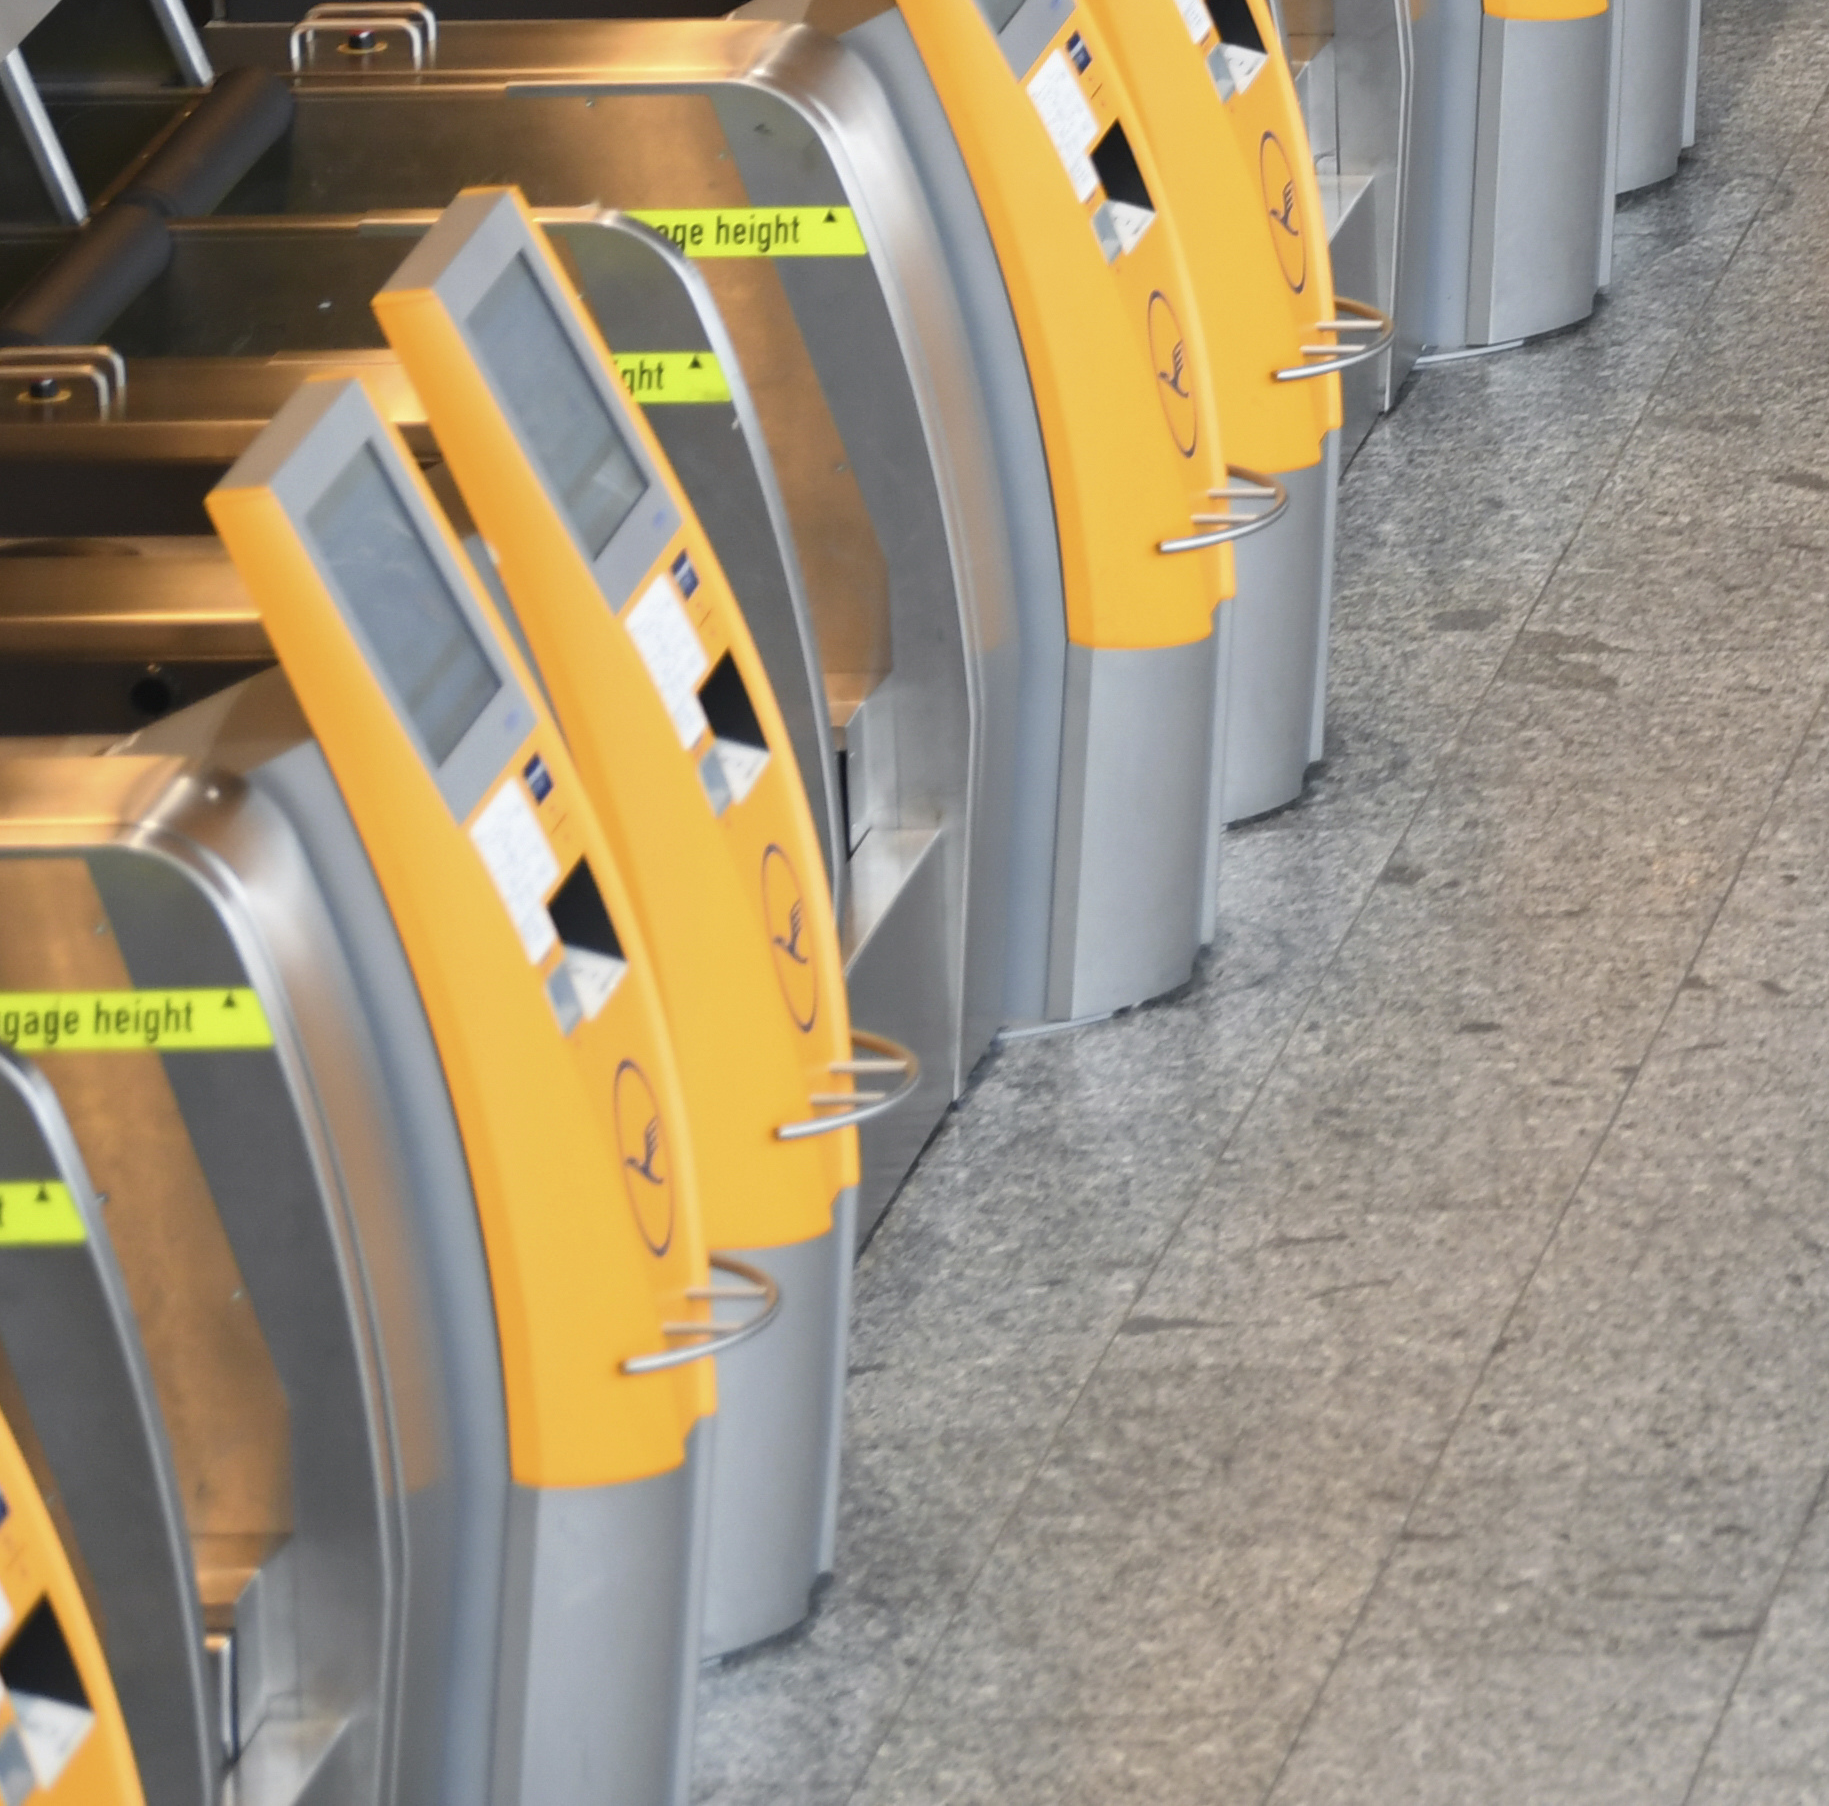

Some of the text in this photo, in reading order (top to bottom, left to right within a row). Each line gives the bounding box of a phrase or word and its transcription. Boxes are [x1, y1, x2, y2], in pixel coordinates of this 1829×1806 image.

[715, 214, 801, 254] height
[2, 998, 194, 1046] gage height
